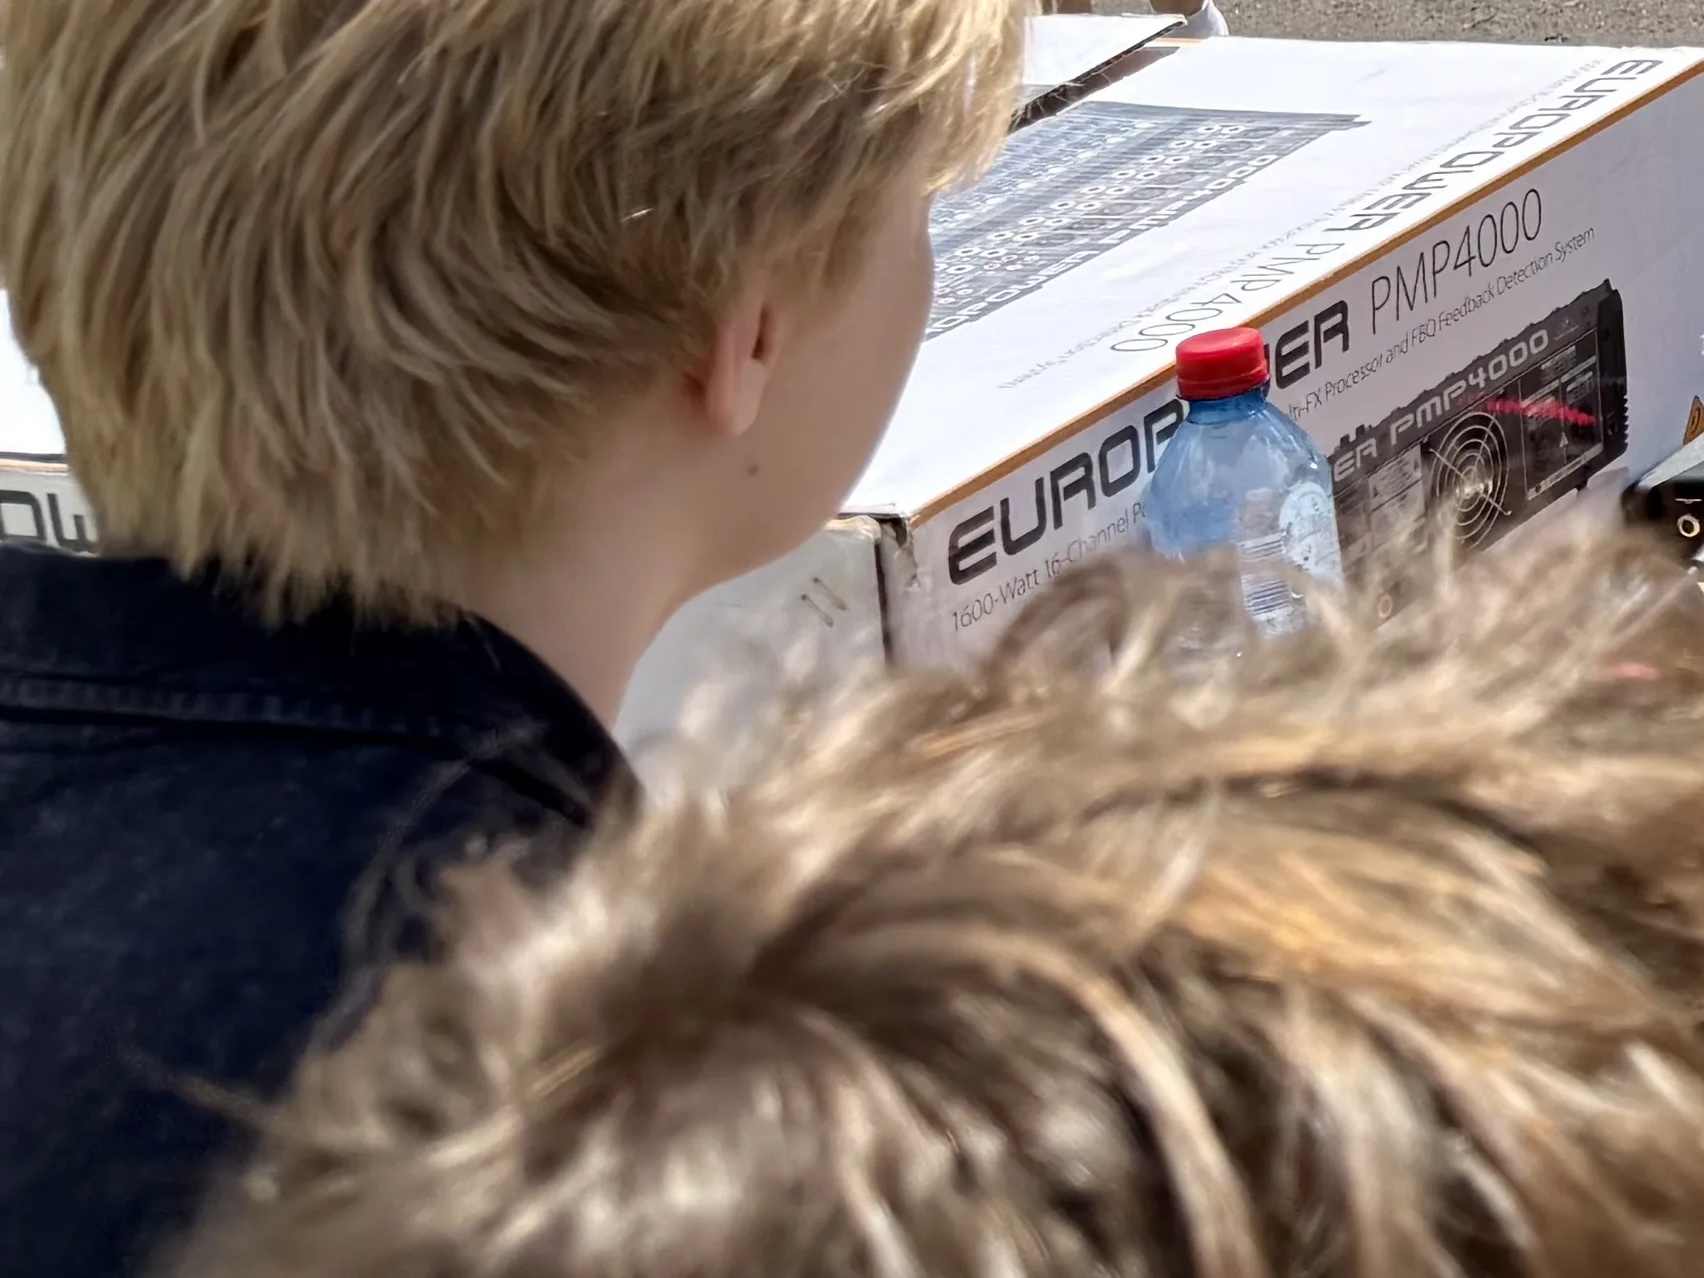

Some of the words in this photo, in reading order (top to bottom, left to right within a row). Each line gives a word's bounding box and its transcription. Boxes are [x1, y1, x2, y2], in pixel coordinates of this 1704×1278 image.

[1322, 59, 1664, 233] EUROPOWER
[1109, 242, 1345, 352] PMP4000
[947, 299, 1351, 585] EUROPER
[1370, 188, 1543, 336] PMP4000
[952, 568, 1041, 632] 1600-Watt
[1325, 346, 1384, 401] Processor
[1386, 330, 1409, 365] and
[1437, 279, 1496, 327] Feedback
[1497, 246, 1553, 297] Detection
[1554, 225, 1596, 264] System
[1389, 328, 1550, 448] PMP4000
